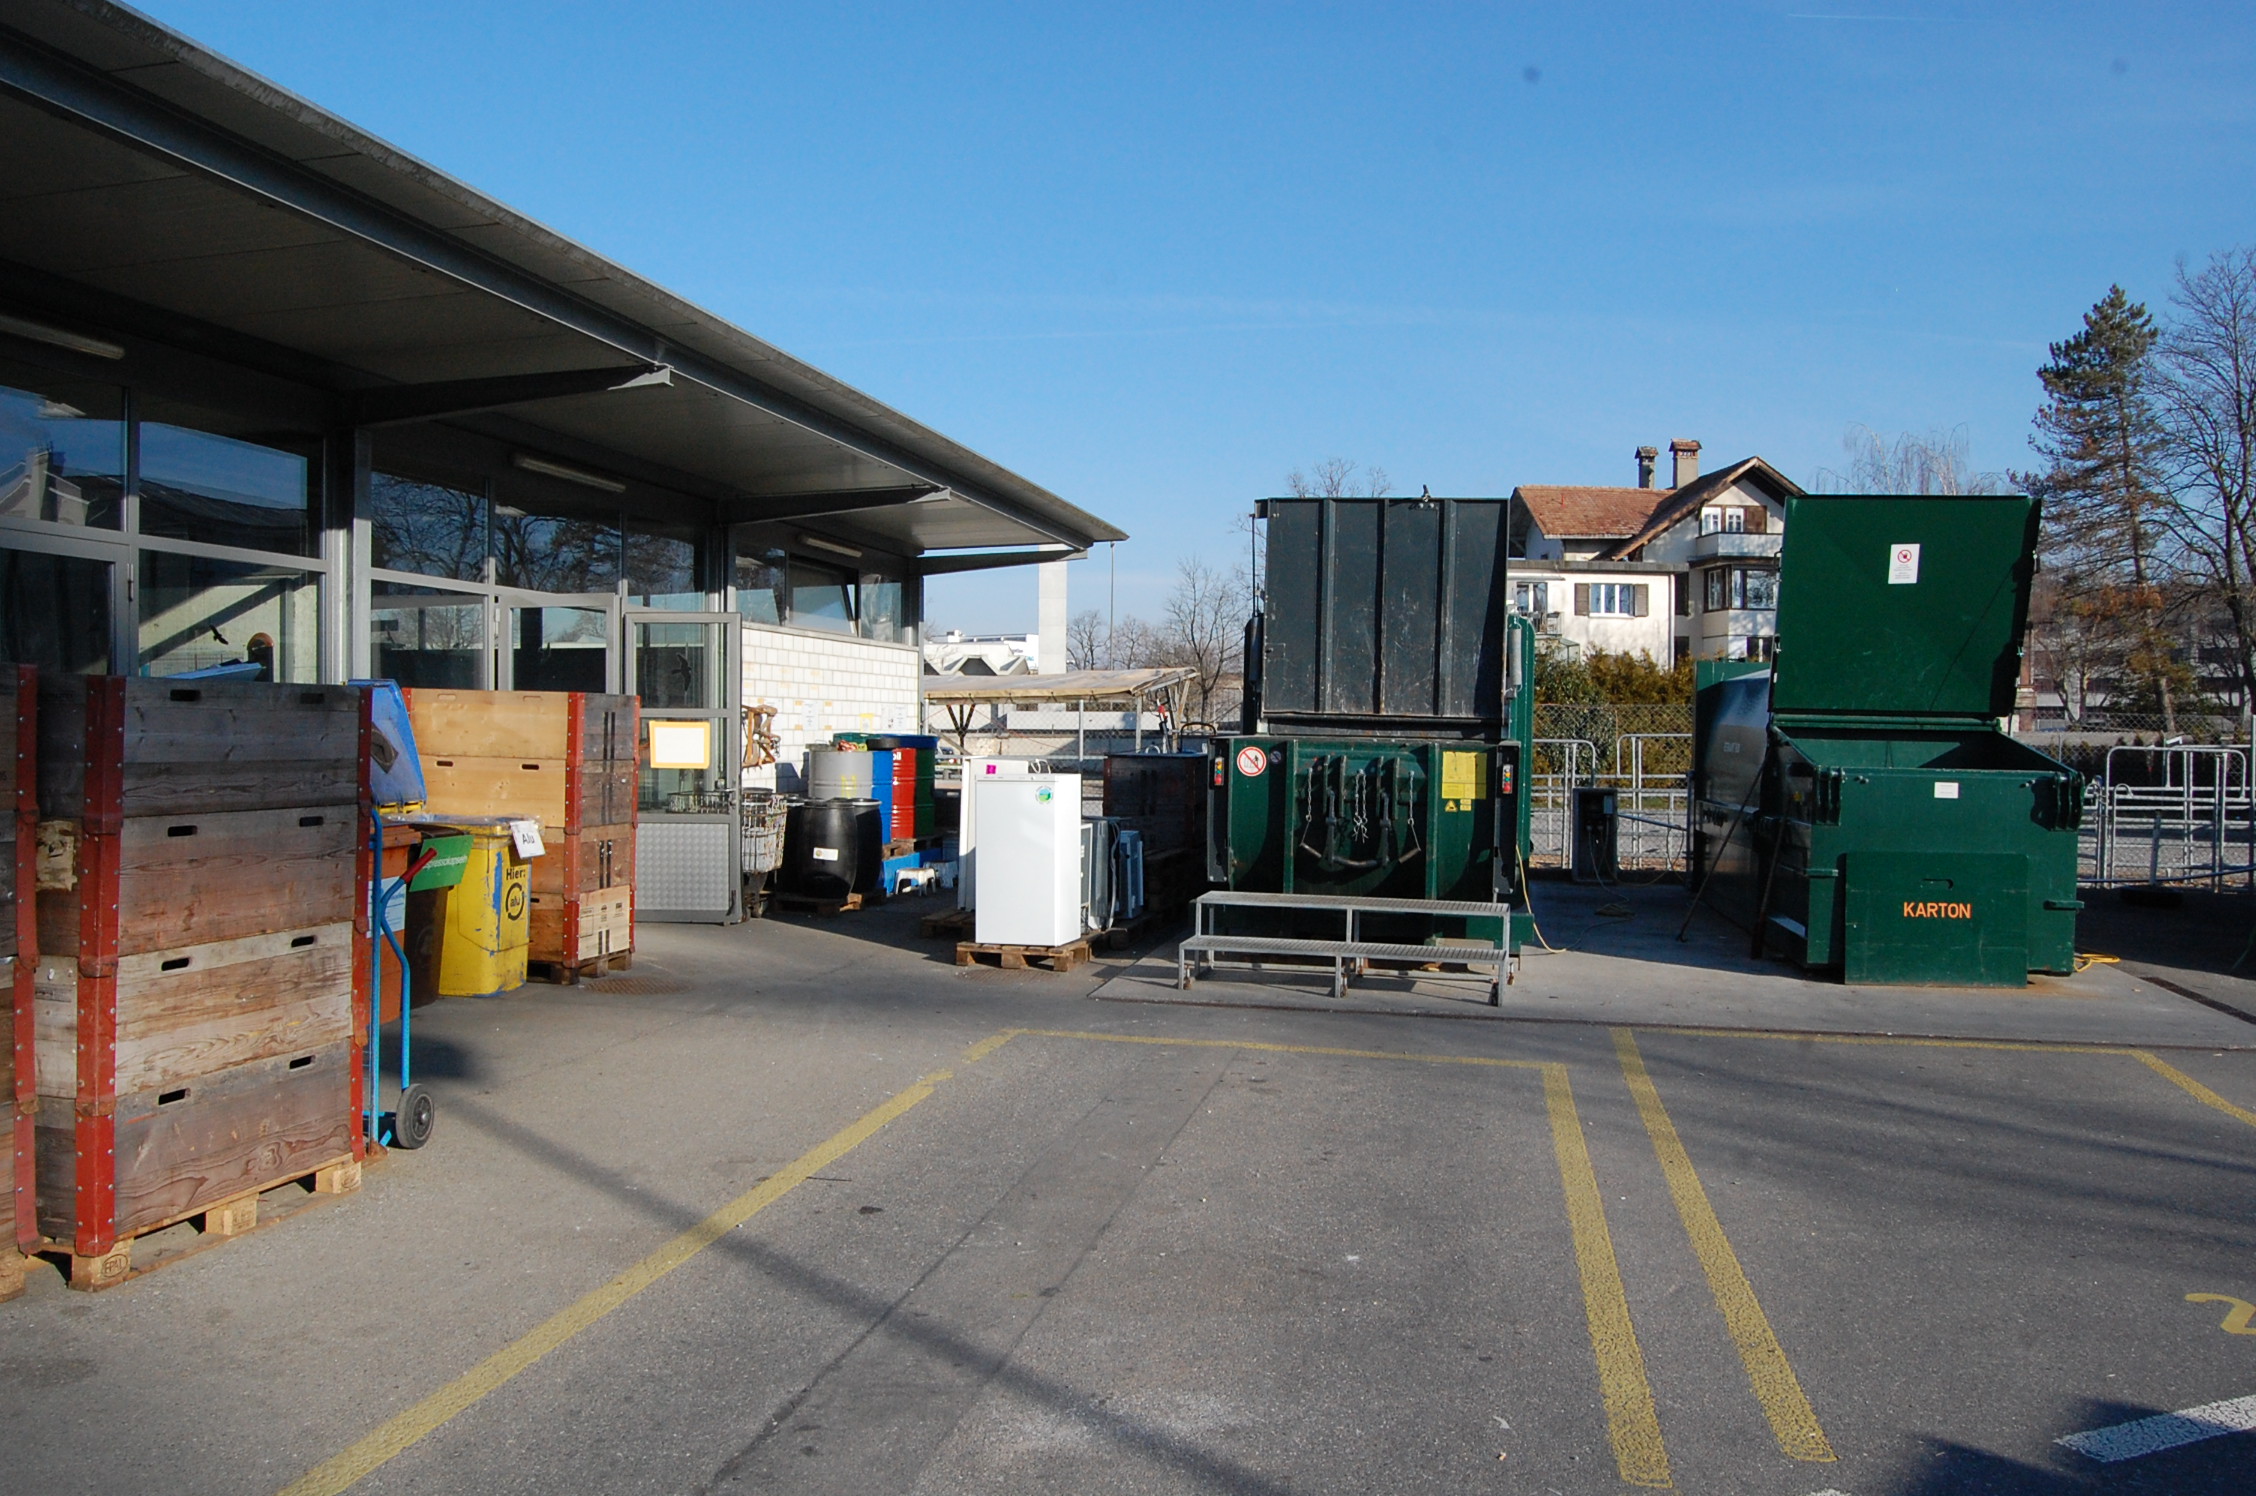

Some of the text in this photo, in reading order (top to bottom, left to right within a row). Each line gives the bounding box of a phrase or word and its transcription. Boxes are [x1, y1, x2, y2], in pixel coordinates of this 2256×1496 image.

[522, 833, 535, 844] Alu
[506, 867, 526, 880] Hier:
[1903, 901, 1972, 919] KARTON
